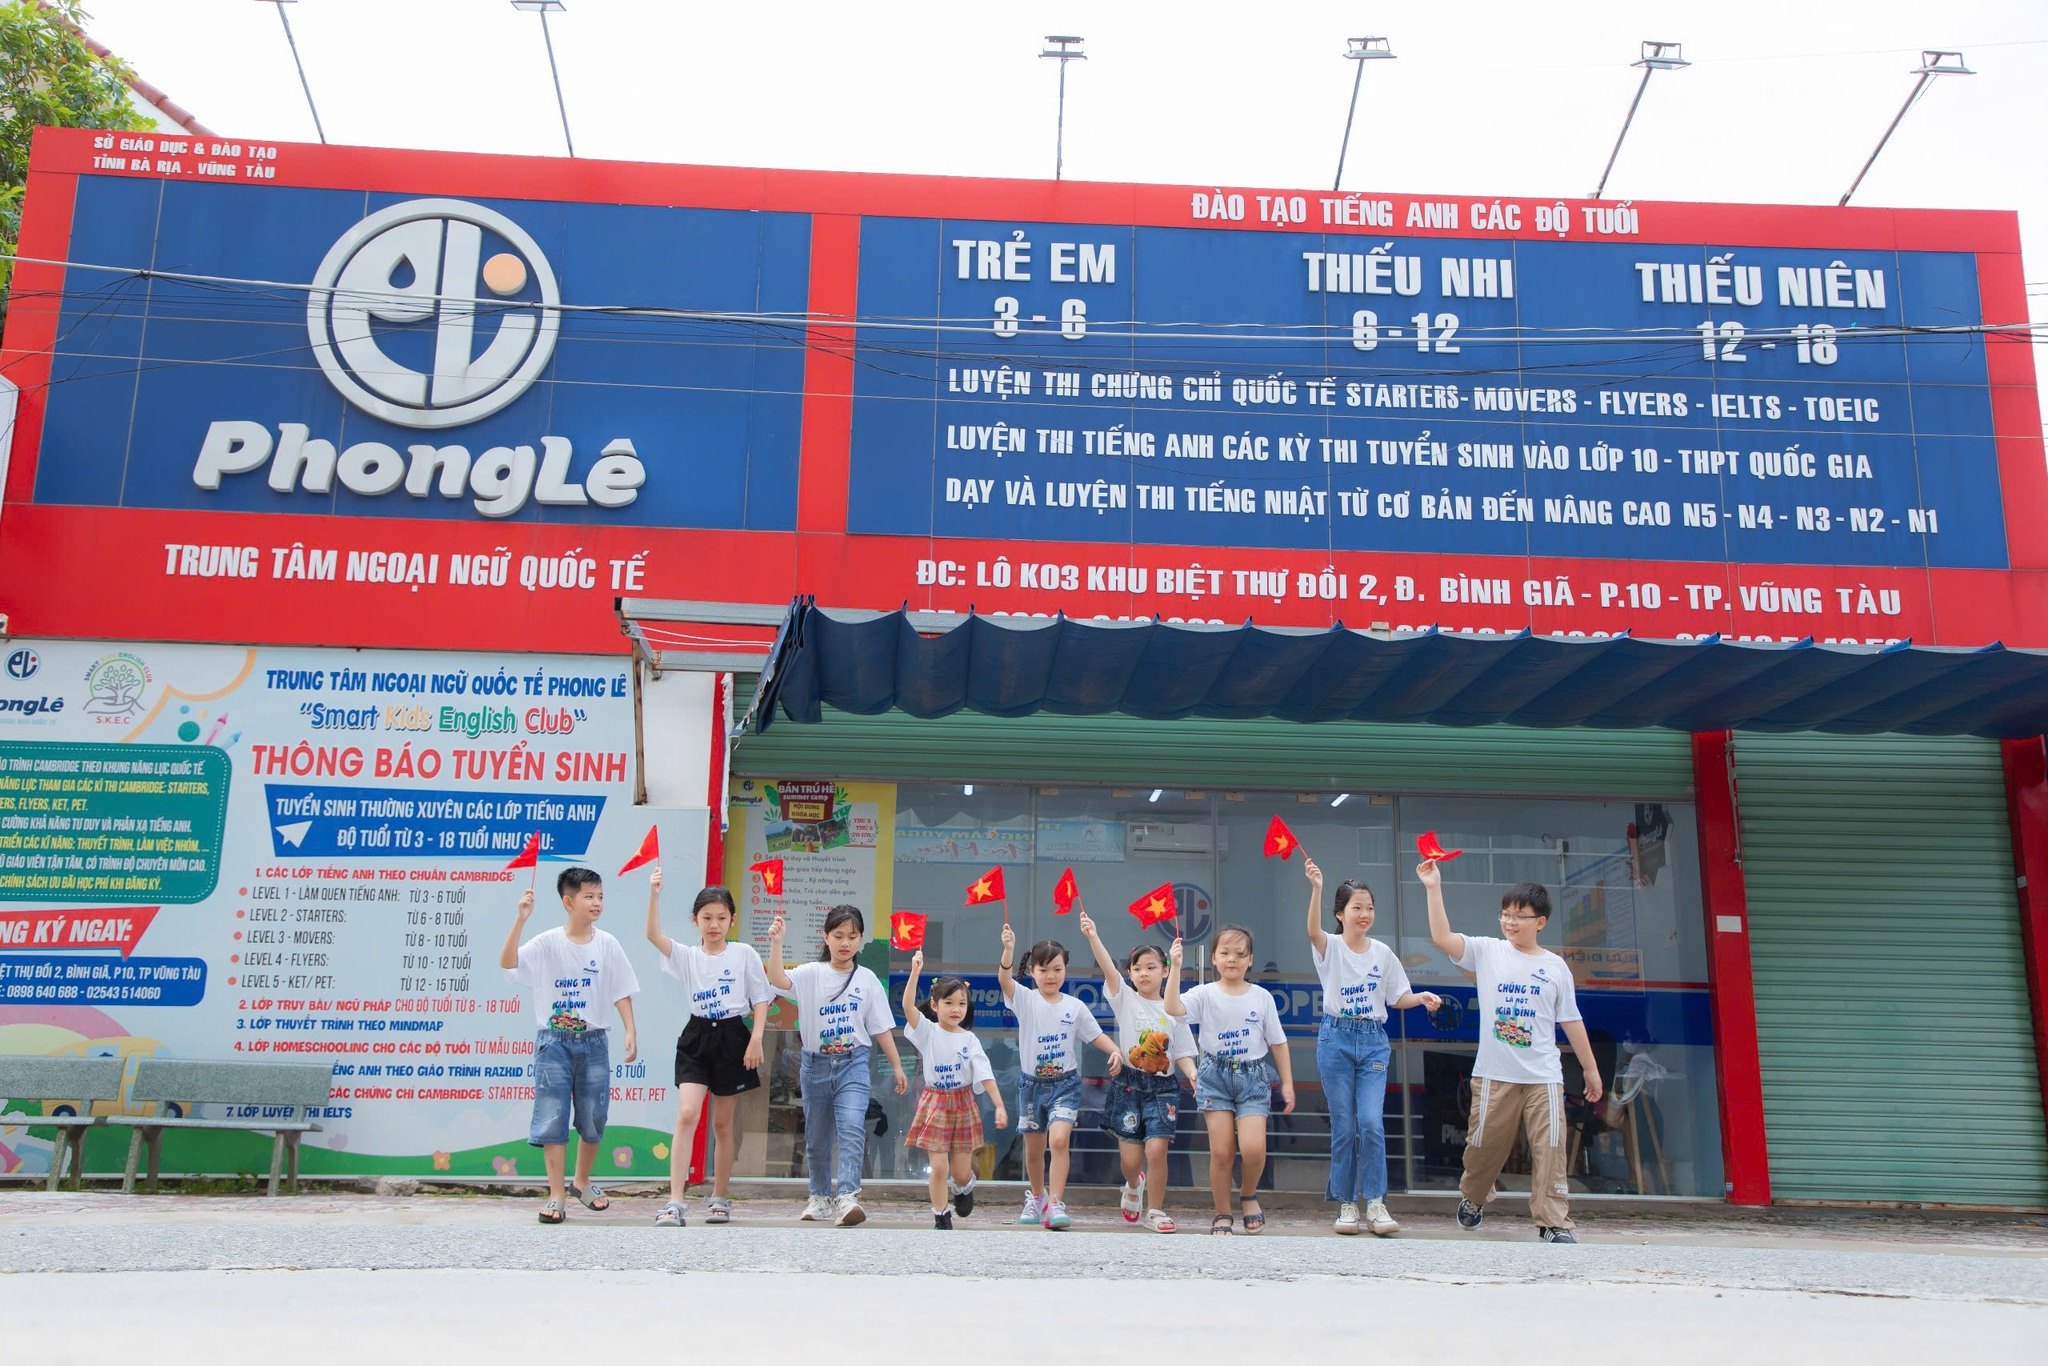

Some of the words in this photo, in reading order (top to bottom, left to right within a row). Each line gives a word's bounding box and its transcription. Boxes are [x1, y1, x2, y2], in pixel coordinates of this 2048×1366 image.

[94, 135, 114, 148] SỞ
[120, 137, 153, 151] GIÁO
[194, 142, 204, 154] &
[211, 142, 241, 156] ĐÀO
[248, 146, 276, 161] TẠO
[93, 156, 125, 169] TỈNH
[131, 157, 150, 171] BÀ
[157, 160, 181, 174] RỊA
[198, 161, 235, 176] VŨNG
[245, 163, 275, 178] TÀU
[1191, 188, 1244, 219] ĐÀO
[1256, 194, 1307, 226] TẠO
[1319, 193, 1393, 226] TIẾNG
[1406, 202, 1457, 228] ANH
[1471, 200, 1520, 230] CÁC
[1535, 201, 1569, 237] ĐỘ
[1582, 199, 1639, 234] TUỔI
[952, 231, 1030, 280] TRẺ
[1051, 243, 1114, 282] EM
[1303, 242, 1421, 295] THIẾU
[1441, 257, 1512, 297] NHI
[1635, 253, 1762, 305] THIẾU
[1778, 260, 1885, 307] NIÊN
[994, 297, 1019, 339] 3
[1061, 299, 1087, 340] 6
[1353, 310, 1377, 351] 6
[1410, 313, 1460, 354] 12
[1696, 321, 1747, 362] 12
[1791, 323, 1838, 366] 18
[949, 365, 1030, 402] LUYỆN
[1041, 372, 1079, 399] THI
[1091, 371, 1171, 399] CHỨNG
[1183, 370, 1220, 400] CHỈ
[1232, 372, 1296, 405] QUỐC
[1306, 377, 1336, 405] TẾ
[1474, 387, 1576, 412] MOVERS
[1600, 391, 1687, 416] FLYERS
[1711, 393, 1780, 419] IELTS
[1803, 397, 1879, 421] TOEIC
[947, 421, 1025, 457] LUYỆN
[1036, 429, 1073, 453] THI
[1082, 424, 1154, 456] TIẾNG
[1165, 433, 1213, 458] ANH
[1223, 431, 1268, 460] CÁC
[1279, 432, 1310, 461] KỲ
[1319, 439, 1357, 462] THI
[1366, 430, 1447, 465] TUYỂN
[1458, 443, 1513, 468] SINH
[1523, 440, 1568, 469] VÀO
[1579, 440, 1623, 471] LỚP
[1631, 448, 1657, 472] 10
[1678, 449, 1739, 474] THPT
[1749, 444, 1815, 479] QUỐC
[1828, 454, 1872, 478] GIA
[192, 420, 647, 518] PhongLê
[165, 544, 258, 577] TRUNG
[272, 542, 337, 580] TÂM
[346, 551, 438, 591] NGOẠI
[449, 546, 511, 586] NGỮ
[520, 547, 595, 590] QUỐC
[609, 550, 651, 591] TẾ
[916, 560, 965, 585] ĐC:
[977, 556, 1010, 587] LÔ
[1088, 566, 1147, 593] KHU
[1157, 563, 1223, 599] BIỆT
[1232, 569, 1288, 603] THỰ
[1297, 565, 1346, 598] ĐỒI
[1394, 576, 1424, 601] Đ.
[1440, 573, 1510, 603] BÌNH
[1523, 576, 1574, 605] GIÃ
[1685, 585, 1730, 610] TP.
[1739, 582, 1822, 613] VŨNG
[1836, 583, 1900, 614] TÀU
[266, 670, 323, 690] TRUNG
[330, 667, 366, 691] TÂM
[372, 672, 425, 697] NGOẠI
[431, 669, 468, 694] NGỮ
[472, 671, 517, 695] QUỐC
[523, 669, 542, 695] TẾ
[548, 677, 605, 696] PHONG
[611, 673, 626, 697] LÊ
[384, 703, 432, 731] Kids
[439, 705, 517, 738] English
[252, 740, 363, 776] THÔNG
[374, 741, 440, 778] BÁO
[452, 741, 544, 780] TUYỂN
[555, 751, 626, 781] SINH
[779, 782, 799, 793] BÁN
[801, 782, 820, 793] TRÚ
[822, 782, 835, 793] HÈ
[276, 792, 320, 815] TUYỂN
[323, 799, 356, 816] SINH
[360, 797, 413, 817] THƯỜNG
[416, 798, 462, 818] XUYÊN
[466, 799, 492, 819] CÁC
[496, 800, 521, 819] LỚP
[525, 799, 563, 820] TIẾNG
[567, 804, 596, 821] ANH
[337, 826, 356, 849] ĐỘ
[360, 824, 390, 846] TUỔI
[394, 827, 412, 847] TỪ
[414, 831, 423, 847] 3
[439, 831, 454, 848] 18
[458, 826, 488, 848] TUỔI
[492, 832, 521, 849] NHƯ
[265, 866, 288, 877] CÁC
[292, 868, 312, 878] LỚP
[317, 866, 348, 878] TIẾNG
[352, 869, 374, 879] ANH
[378, 870, 405, 880] THEO
[450, 871, 516, 881] CAMBRIDGE:
[252, 886, 280, 899] LEVEL
[285, 887, 288, 898] 1
[298, 884, 318, 899] LÀM
[321, 887, 346, 900] QUEN
[349, 884, 375, 901] TIẾNG
[378, 888, 400, 901] ANH:
[410, 888, 421, 902] TỪ
[446, 885, 465, 903] TUỔI
[33, 916, 66, 942] KÝ
[69, 919, 132, 941] NGAY:
[7, 985, 34, 997] 0898
[35, 985, 55, 997] 640
[58, 986, 78, 998] 688
[86, 986, 119, 998] 02543
[121, 986, 160, 999] 514060
[1497, 982, 1527, 994] CHÚNG
[1530, 985, 1541, 995] TA
[250, 1018, 271, 1029] LỚP
[275, 1019, 316, 1029] THUYẾT
[321, 1020, 353, 1029] TRÌNH
[358, 1020, 385, 1030] THEO
[389, 1021, 443, 1031] MINDMAP
